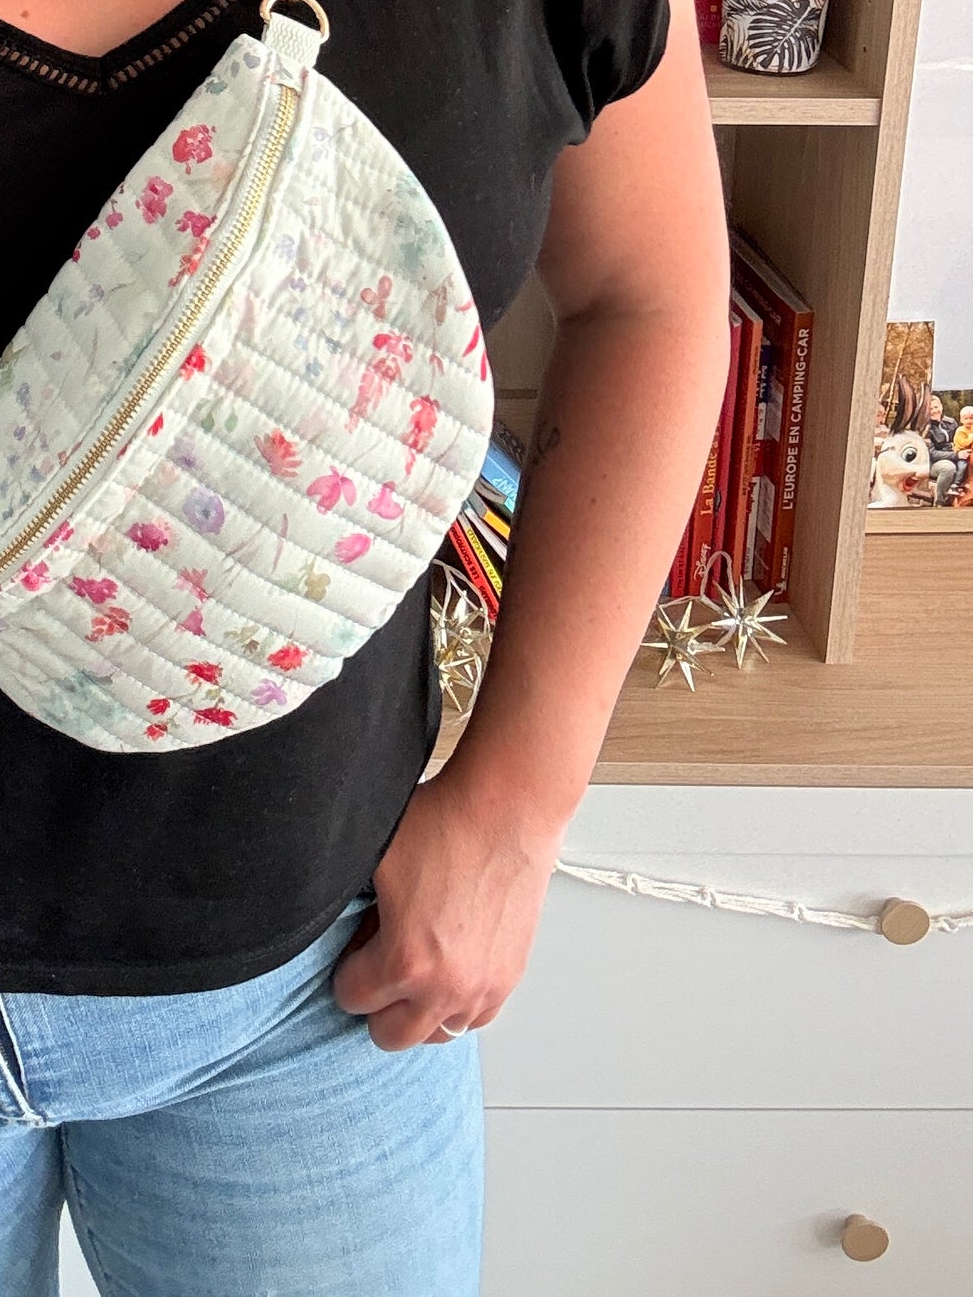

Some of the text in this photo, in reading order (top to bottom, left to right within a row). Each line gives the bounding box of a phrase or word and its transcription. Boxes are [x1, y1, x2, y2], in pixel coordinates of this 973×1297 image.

[703, 447, 719, 499] Bande
[782, 327, 810, 510] L'EUROPE EN CAMPING-CAR
